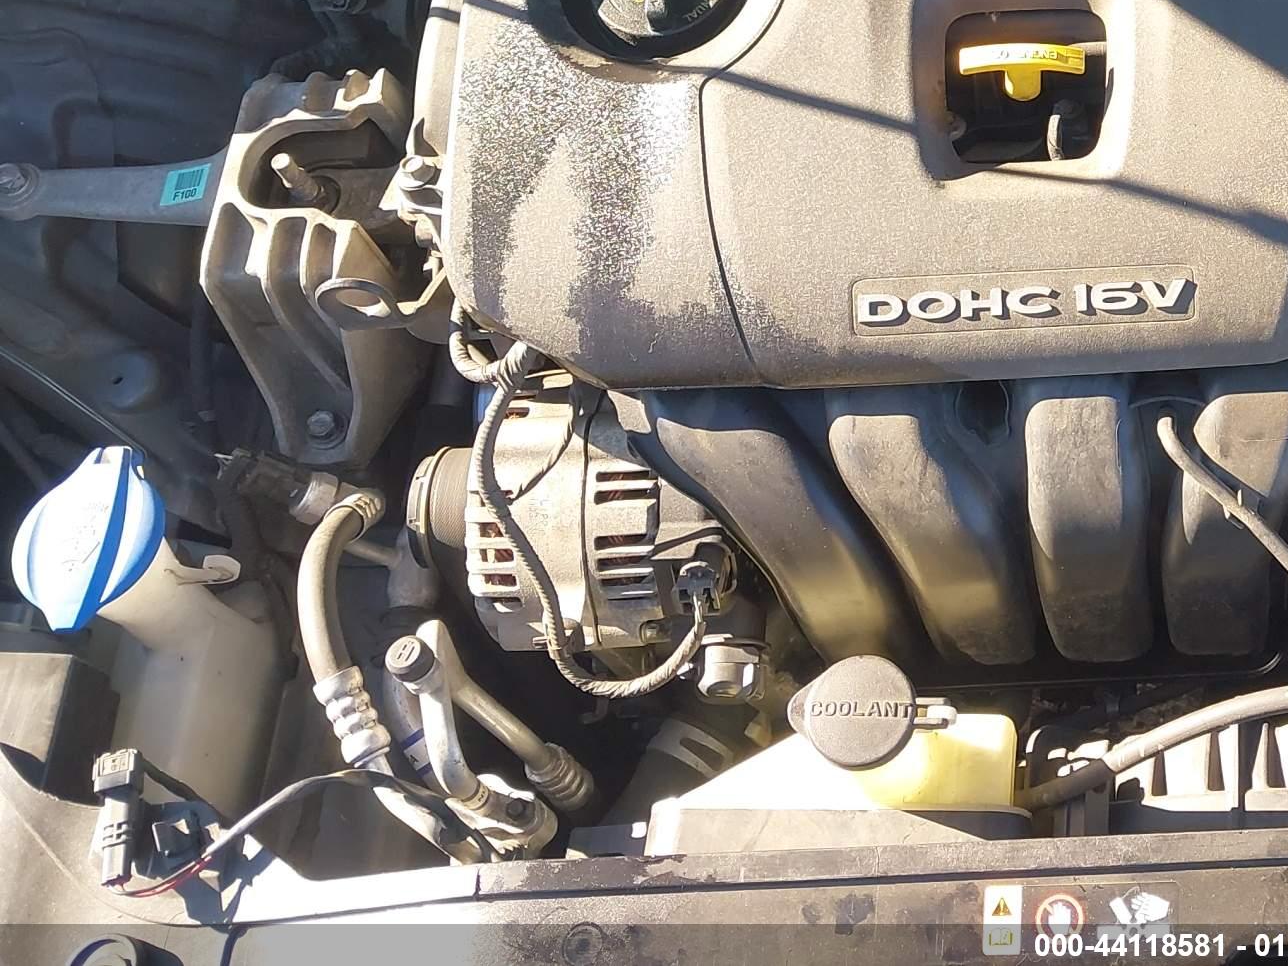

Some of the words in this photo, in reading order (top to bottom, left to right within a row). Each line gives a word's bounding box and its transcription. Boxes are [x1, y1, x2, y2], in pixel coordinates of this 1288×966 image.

[173, 188, 197, 201] F100
[858, 286, 1062, 327] DOHC
[1073, 278, 1198, 316] 16V
[811, 701, 914, 718] COOLANT
